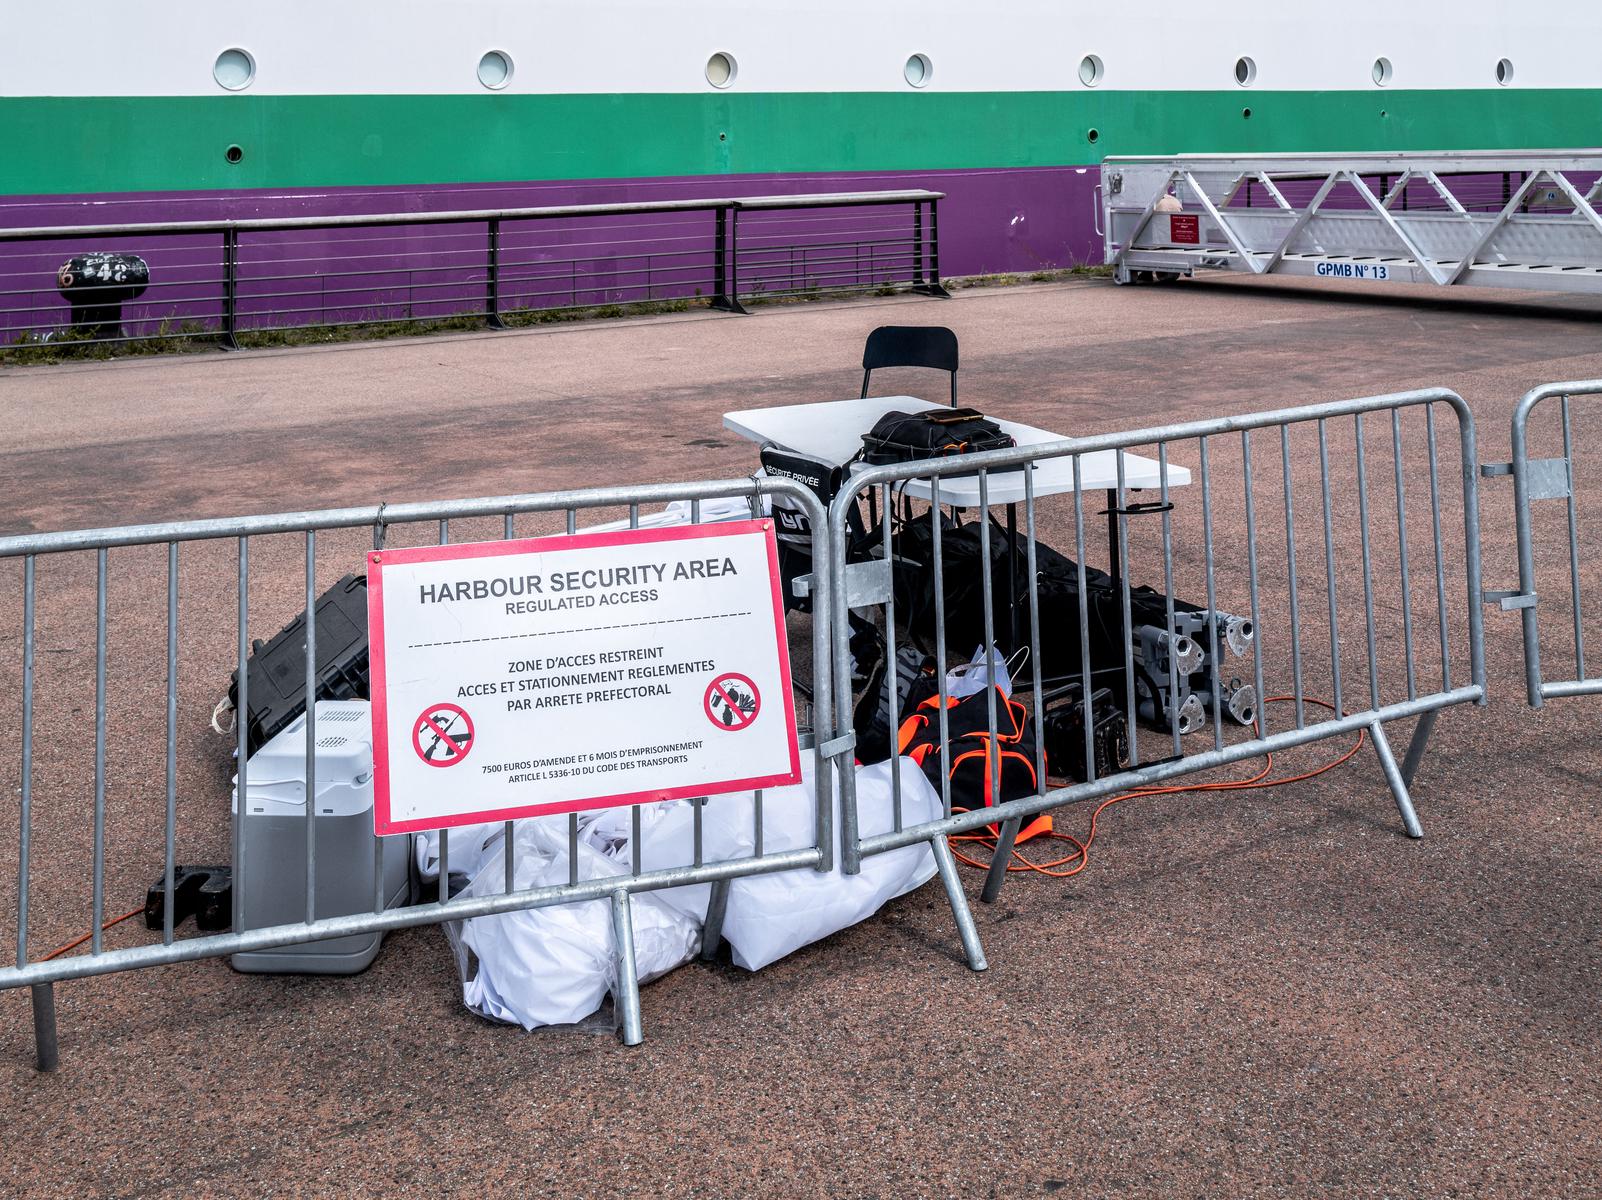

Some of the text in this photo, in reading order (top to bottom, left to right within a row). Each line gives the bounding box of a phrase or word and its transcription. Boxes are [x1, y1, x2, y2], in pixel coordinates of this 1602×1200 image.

[1317, 262, 1387, 279] GPMB N° 13
[792, 473, 819, 487] PRIVÉE
[420, 557, 738, 604] HARBOUR SECURITY AREA
[505, 588, 659, 615] REGULATED ACCESS
[508, 646, 664, 673] ZONE D'ACCES RESTREINT
[457, 659, 715, 698] ACCES ET STATIONNEMENT REGLEMENTES
[507, 683, 672, 712] PAR ARRETE PREFECTORAL
[482, 764, 502, 774] 7500
[503, 761, 532, 772] EUROS
[578, 754, 587, 763] ET
[589, 753, 595, 762] 6
[595, 750, 618, 761] MOIS
[508, 754, 689, 784] ARTICLE L 5336-10 DU CODE DES TRANSPORTS
